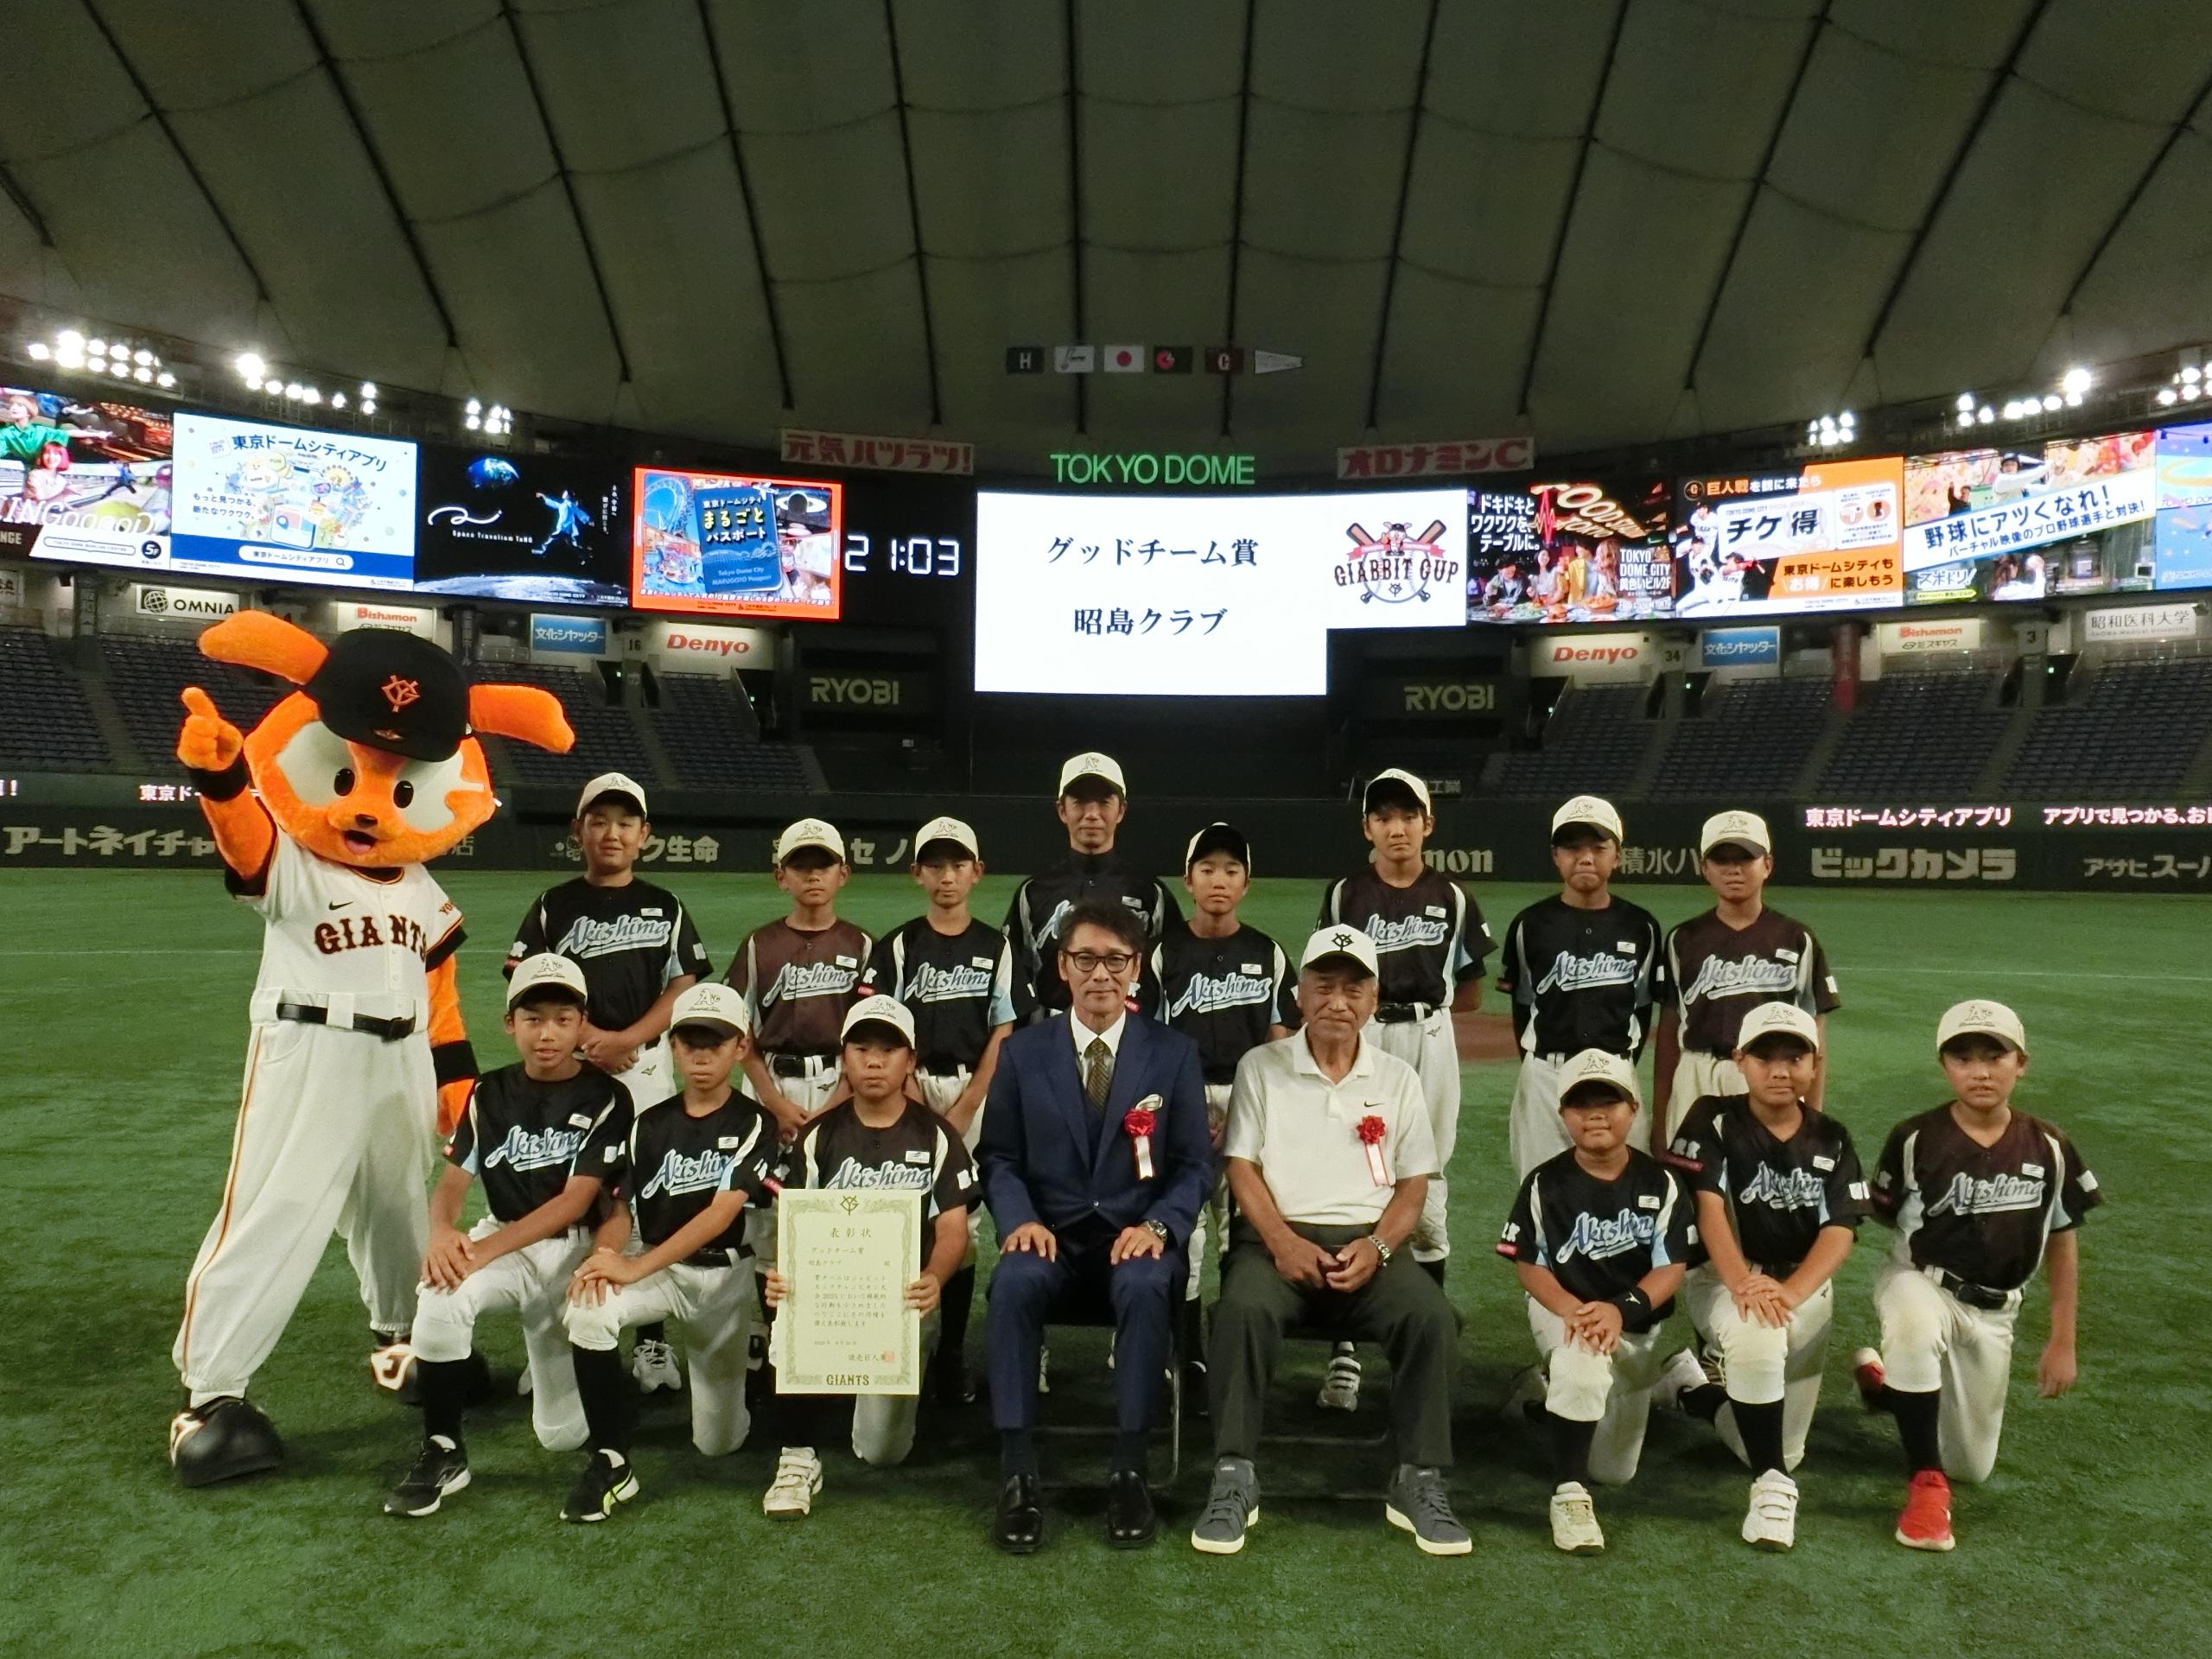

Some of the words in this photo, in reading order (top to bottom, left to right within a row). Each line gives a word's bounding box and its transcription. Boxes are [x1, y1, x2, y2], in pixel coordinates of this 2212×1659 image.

[232, 435, 387, 472] 東京ドームシティアプリ
[1343, 439, 1528, 477] オロナミンC
[1050, 454, 1158, 484] TOKYO
[1165, 455, 1255, 486] DOME
[1480, 493, 1535, 516] ドキドキと
[1924, 485, 2110, 550] 野球にアツくなれ!
[703, 508, 766, 530] まるごと
[706, 526, 766, 543] パスポート
[1479, 534, 1540, 553] テーブルに。
[1047, 536, 1259, 568] グッドチーム賞
[1620, 549, 1652, 563] TOKYO
[1334, 557, 1413, 587] GIABBIT
[1419, 557, 1459, 584] CUP
[1620, 564, 1649, 577] DOME
[1650, 563, 1671, 576] CITY
[1783, 558, 1894, 576] 東京ドームシティも
[357, 607, 417, 622] Bishamon
[1073, 607, 1228, 636] 昭島クラブ
[2091, 610, 2190, 630] 昭和医科大学
[628, 639, 640, 651] 16
[667, 634, 750, 657] Denyo
[1553, 646, 1638, 664] Denyo
[1664, 650, 1680, 662] 34
[810, 677, 899, 705] RYOBI
[1403, 684, 1494, 711] RYOBI
[1806, 807, 2012, 828] 東京ドームシティアプリ
[1811, 848, 2017, 881] ビックカメラ
[315, 914, 427, 963] GIANTS
[555, 914, 671, 959] Akishima
[761, 962, 859, 1007] Akishima
[1536, 950, 1637, 995] Akishima
[1686, 953, 1798, 1005] Akishima
[1172, 972, 1273, 1017] Akishima
[826, 1156, 934, 1192] Akishima
[830, 1227, 872, 1237] 表彰状
[826, 1374, 870, 1386] GIANTS
